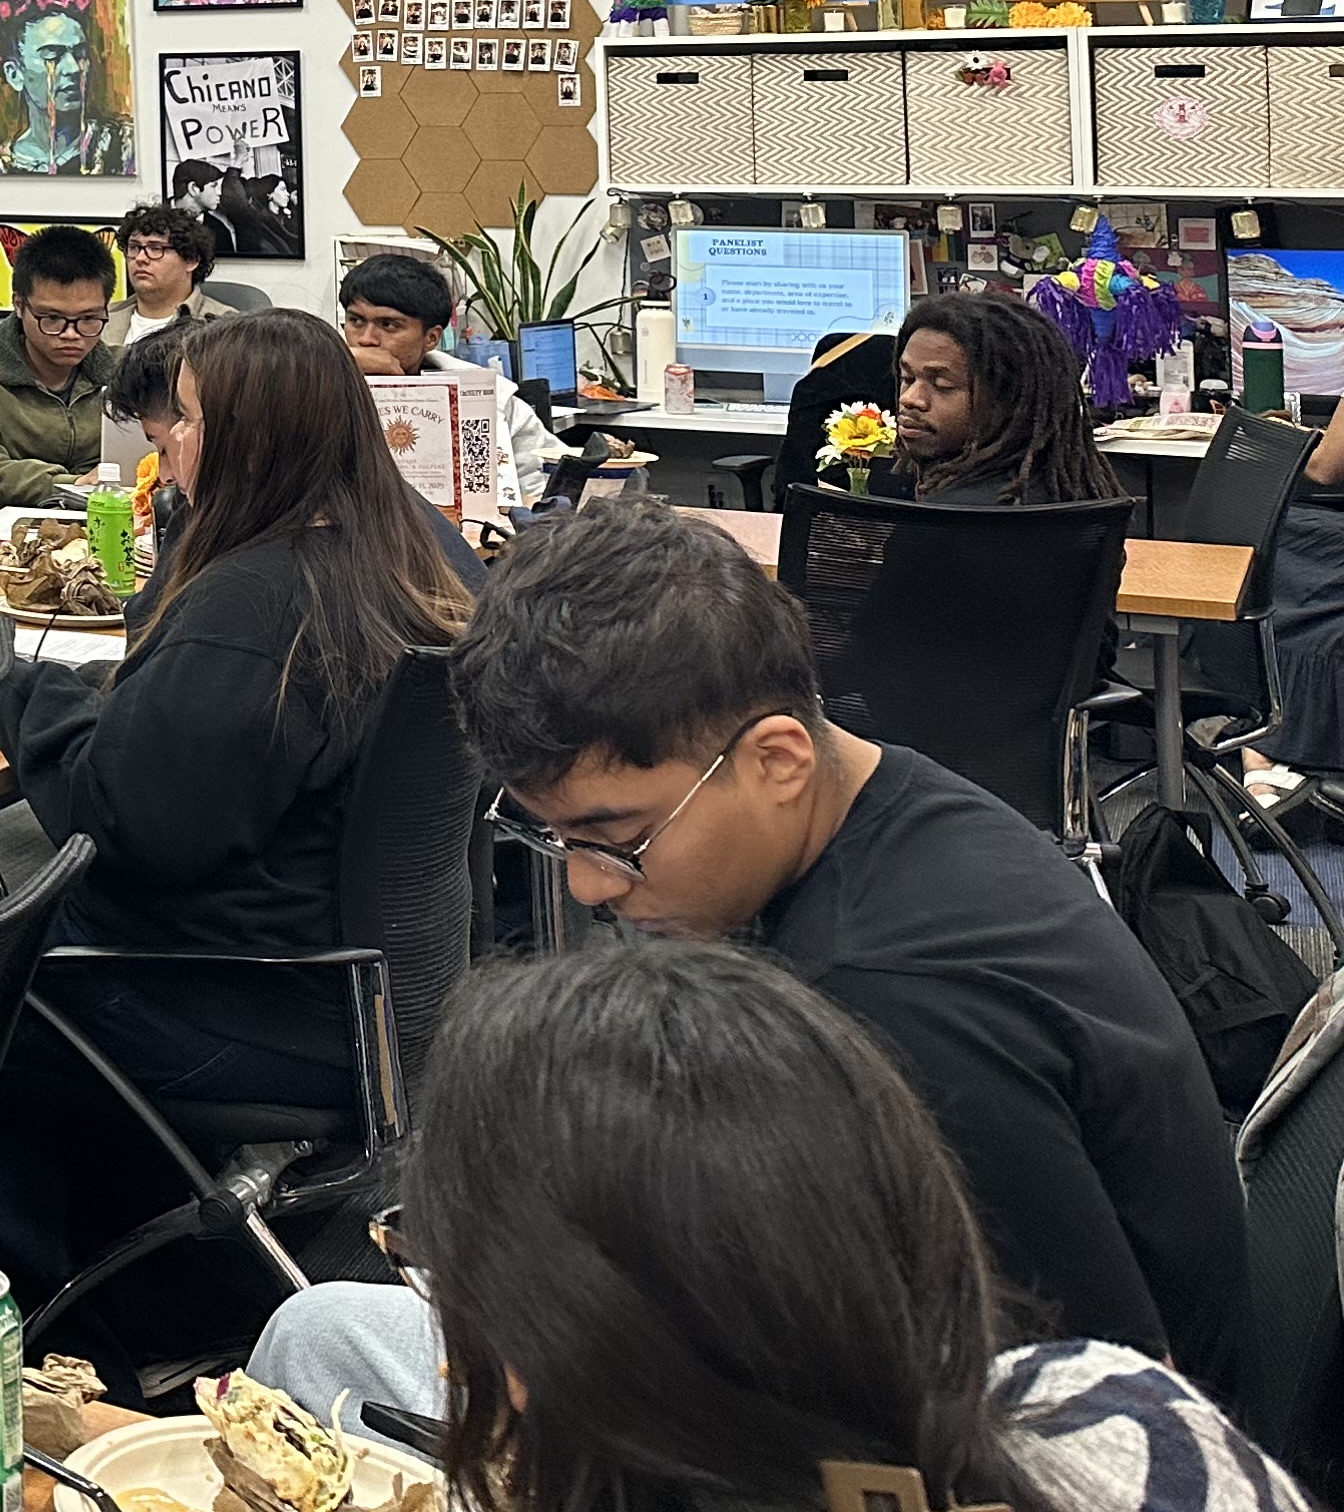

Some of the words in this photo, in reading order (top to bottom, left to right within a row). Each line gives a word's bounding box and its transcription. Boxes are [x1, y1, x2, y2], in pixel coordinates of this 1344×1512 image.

[180, 107, 284, 150] POWER
[712, 238, 764, 247] PANELIST
[708, 247, 767, 256] QUESTIONS
[703, 293, 709, 301] 1
[393, 405, 409, 415] WE
[411, 406, 445, 425] CARRY
